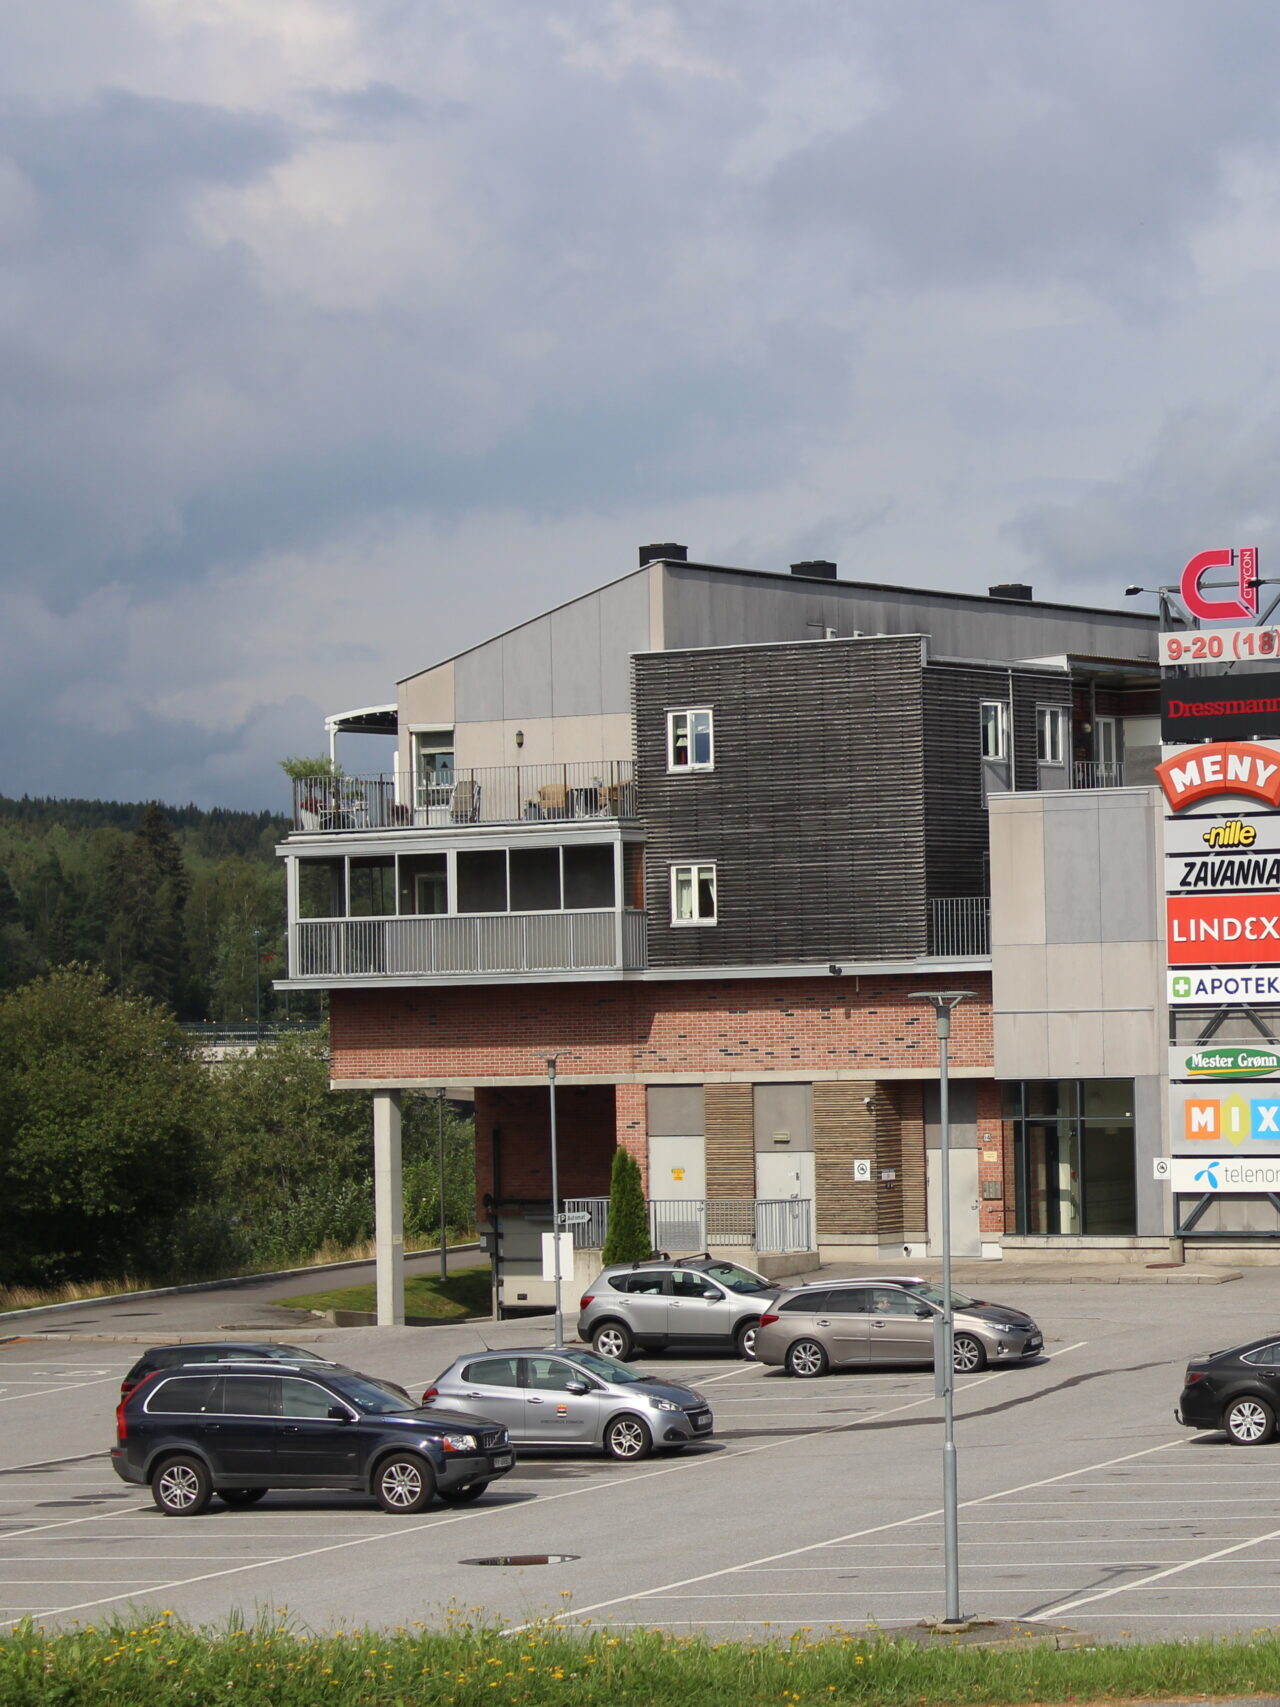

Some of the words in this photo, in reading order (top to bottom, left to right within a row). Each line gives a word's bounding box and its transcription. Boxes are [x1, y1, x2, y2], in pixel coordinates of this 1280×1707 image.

[1167, 635, 1224, 661] 9-20
[1168, 754, 1279, 794] MENY
[1172, 916, 1280, 943] LINDEX
[1195, 976, 1280, 996] APOTEK
[1191, 1053, 1234, 1068] Mester
[1237, 1052, 1278, 1068] Grønn
[1191, 1105, 1280, 1133] MIX
